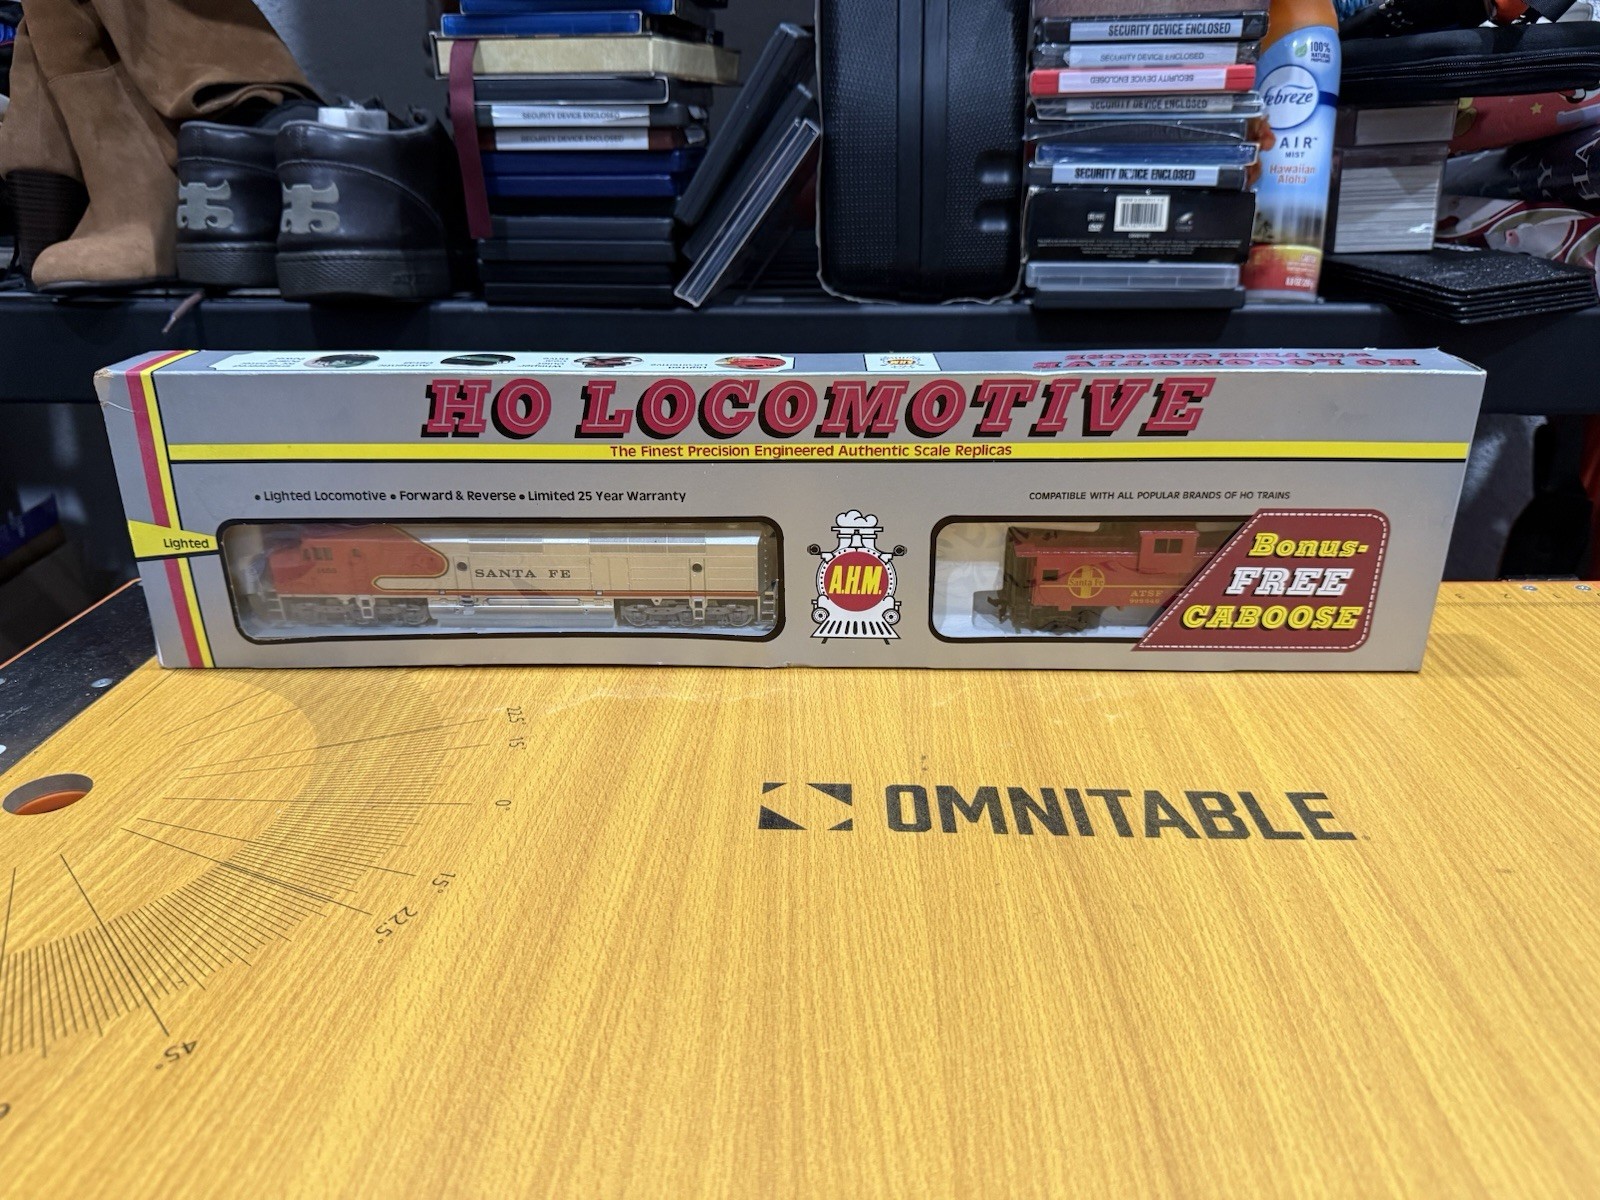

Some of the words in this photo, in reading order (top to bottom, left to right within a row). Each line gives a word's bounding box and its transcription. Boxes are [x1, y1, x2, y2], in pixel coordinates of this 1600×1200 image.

[1108, 23, 1150, 37] SECURITY
[1152, 23, 1184, 36] DEVICE
[1186, 22, 1231, 35] ENCLOSED
[1310, 41, 1331, 53] 100%
[1100, 54, 1136, 62] SECURITY
[1137, 53, 1164, 61] DEVICE
[1165, 52, 1205, 61] ENCLOSED
[1090, 76, 1129, 84] ENCLOSED
[1130, 75, 1157, 83] DEVICE
[1158, 74, 1194, 82] SECURITY
[1263, 85, 1314, 106] febreze
[1090, 100, 1131, 110] SECURITY
[1133, 100, 1161, 110] DEVICE
[1164, 99, 1208, 109] ENCLOSED
[521, 112, 556, 120] SECURITY
[557, 112, 582, 120] DEVICE
[520, 135, 556, 143] SECURITY
[557, 135, 583, 143] DEVICE
[585, 135, 624, 143] ENCLOSED
[1074, 168, 1116, 180] SECURITY
[1118, 168, 1149, 180] DEICE
[1151, 169, 1196, 181] ENCLOSED
[1269, 164, 1316, 174] Hawaiian
[1277, 174, 1307, 184] Aloha
[1032, 358, 1345, 369] LOCOMOTIVE
[1355, 358, 1420, 366] HO
[421, 378, 552, 439] HO
[574, 377, 1216, 439] LOCOMOTIVE
[610, 445, 636, 457] The
[641, 445, 683, 457] Finest
[688, 445, 749, 457] Precision
[754, 445, 834, 459] Engineered
[838, 445, 909, 457] Authentic
[914, 444, 950, 457] Scale
[955, 444, 1012, 458] Replicas
[263, 490, 311, 503] Lighted
[315, 490, 387, 501] Locomotive
[399, 490, 453, 501] Forward
[456, 490, 464, 501] &
[467, 491, 516, 501] Reverse
[528, 490, 575, 501] Limited
[577, 491, 593, 501] 25
[596, 490, 624, 501] Year
[627, 490, 687, 503] Warranty
[1029, 491, 1087, 500] COMPATIBLE
[1090, 491, 1115, 500] WITH
[1117, 491, 1134, 500] ALL
[1137, 491, 1180, 500] POPULAR
[1182, 491, 1221, 500] BRANDS
[1224, 491, 1238, 500] OF
[1239, 491, 1254, 500] HO
[1257, 491, 1291, 500] TRAINS
[163, 538, 210, 550] Lighted
[1247, 532, 1369, 559] Bonus-
[475, 569, 537, 578] SANTA
[548, 569, 571, 578] FE
[828, 565, 883, 595] A.H.M.
[1222, 566, 1354, 597] FREE
[1130, 589, 1164, 597] ATSF
[1180, 604, 1364, 631] CABOOSE
[885, 783, 1358, 841] OMNITABLE
[375, 906, 418, 944] 22.5°
[155, 1040, 197, 1070] 45°
